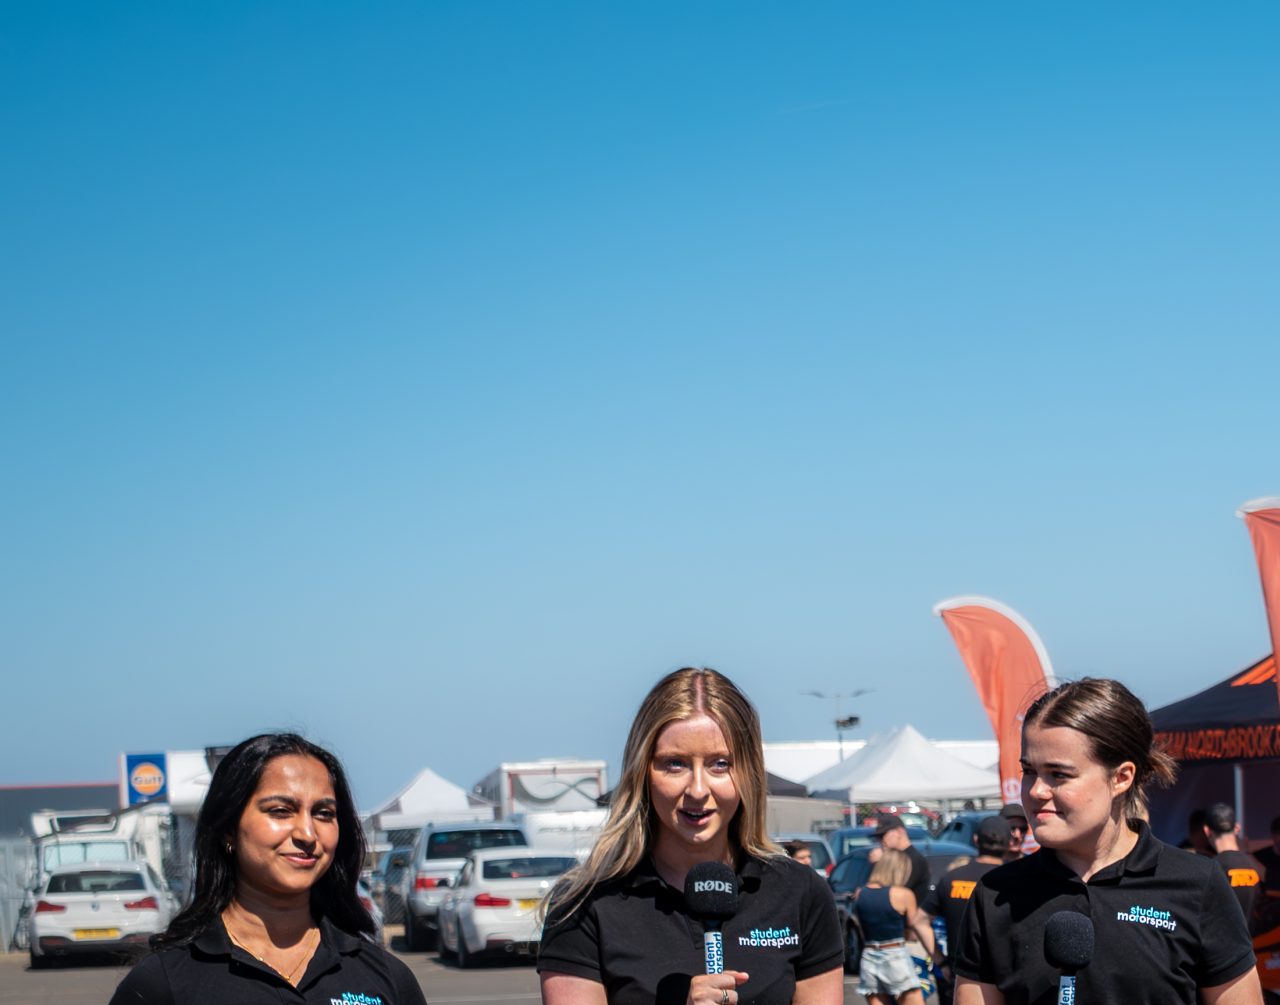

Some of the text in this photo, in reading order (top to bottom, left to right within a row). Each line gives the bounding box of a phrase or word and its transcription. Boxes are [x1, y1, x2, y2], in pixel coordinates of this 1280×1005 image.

[694, 880, 732, 894] RØDE
[1130, 905, 1171, 920] student
[1117, 911, 1177, 931] motorsport
[750, 927, 790, 939] student
[739, 934, 799, 948] motorsport
[705, 941, 716, 975] udent
[712, 933, 723, 975] orsport
[342, 992, 382, 1005] student
